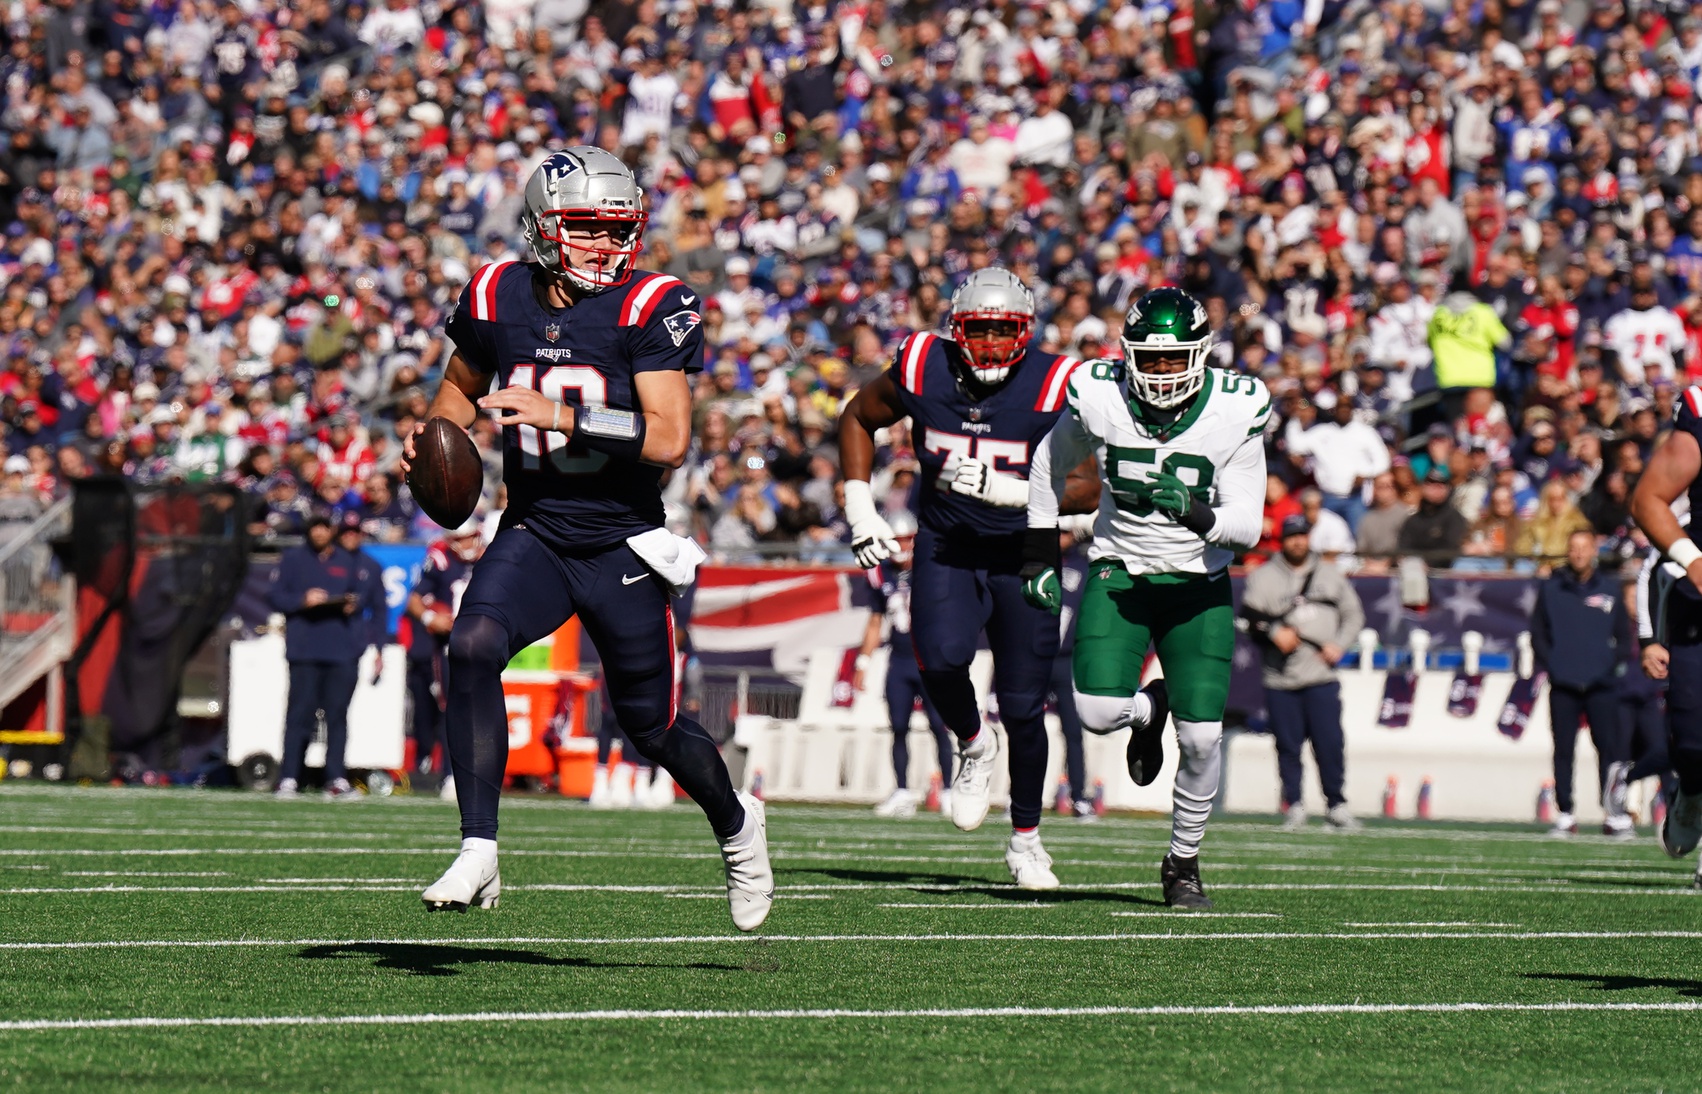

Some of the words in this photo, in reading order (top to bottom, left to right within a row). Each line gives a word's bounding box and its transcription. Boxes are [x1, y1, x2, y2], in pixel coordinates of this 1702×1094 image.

[535, 348, 572, 358] PATRIOTS
[506, 364, 609, 473] 10
[1106, 444, 1215, 521] 58
